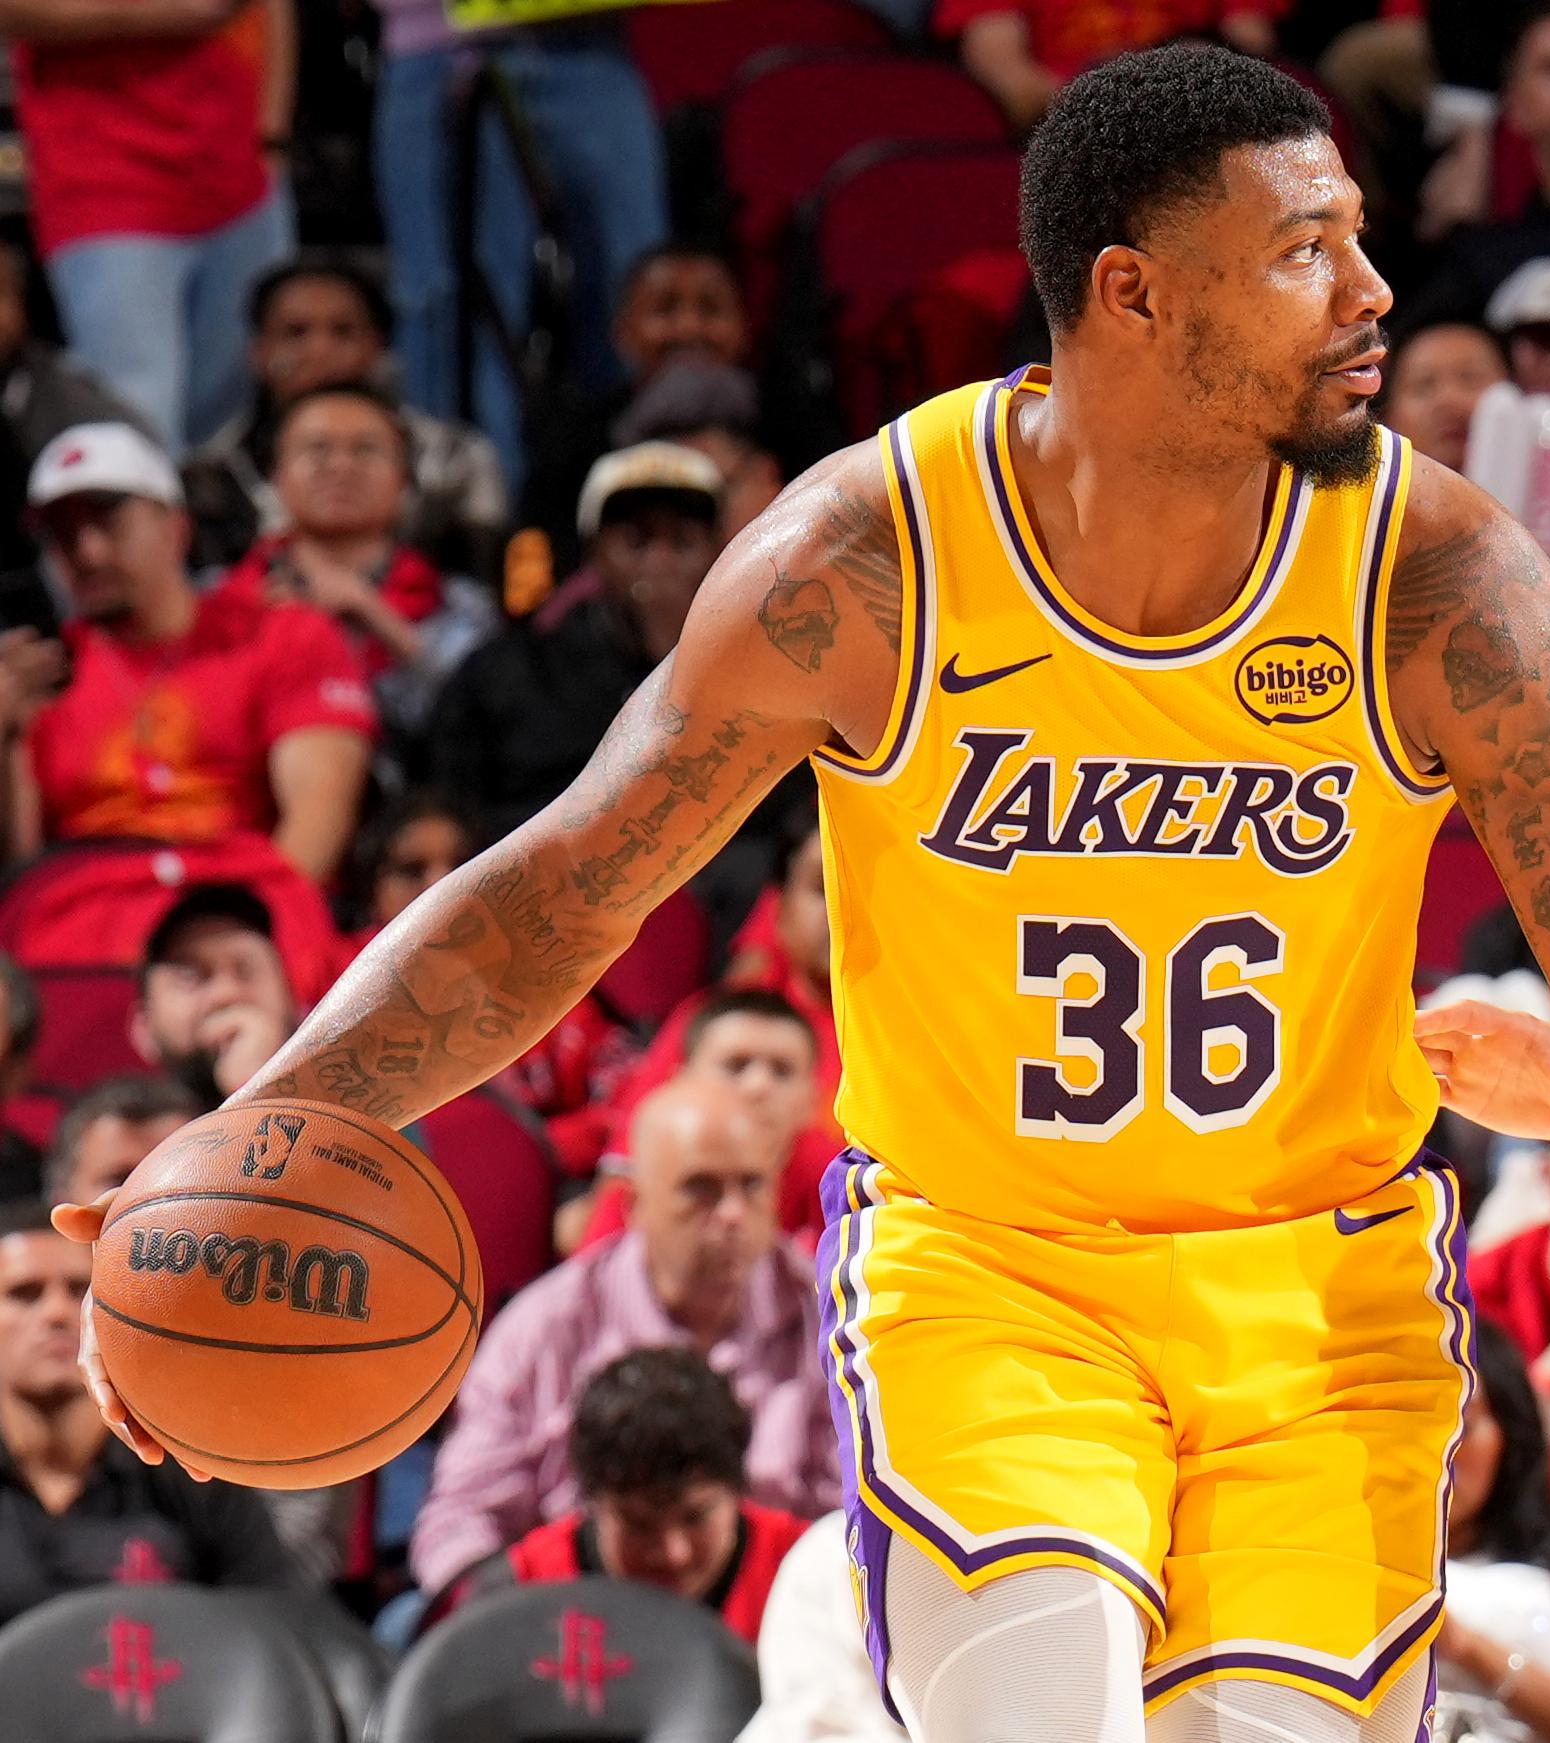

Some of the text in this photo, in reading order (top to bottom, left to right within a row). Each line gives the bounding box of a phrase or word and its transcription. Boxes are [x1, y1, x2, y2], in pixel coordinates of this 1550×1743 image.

[1245, 658, 1347, 697] bibigo
[1265, 689, 1308, 706] 비비고
[917, 726, 1359, 880] LAKERS
[1015, 911, 1286, 1144] 36
[358, 1163, 393, 1192] OFFICIAL
[129, 1227, 371, 1323] Wilson
